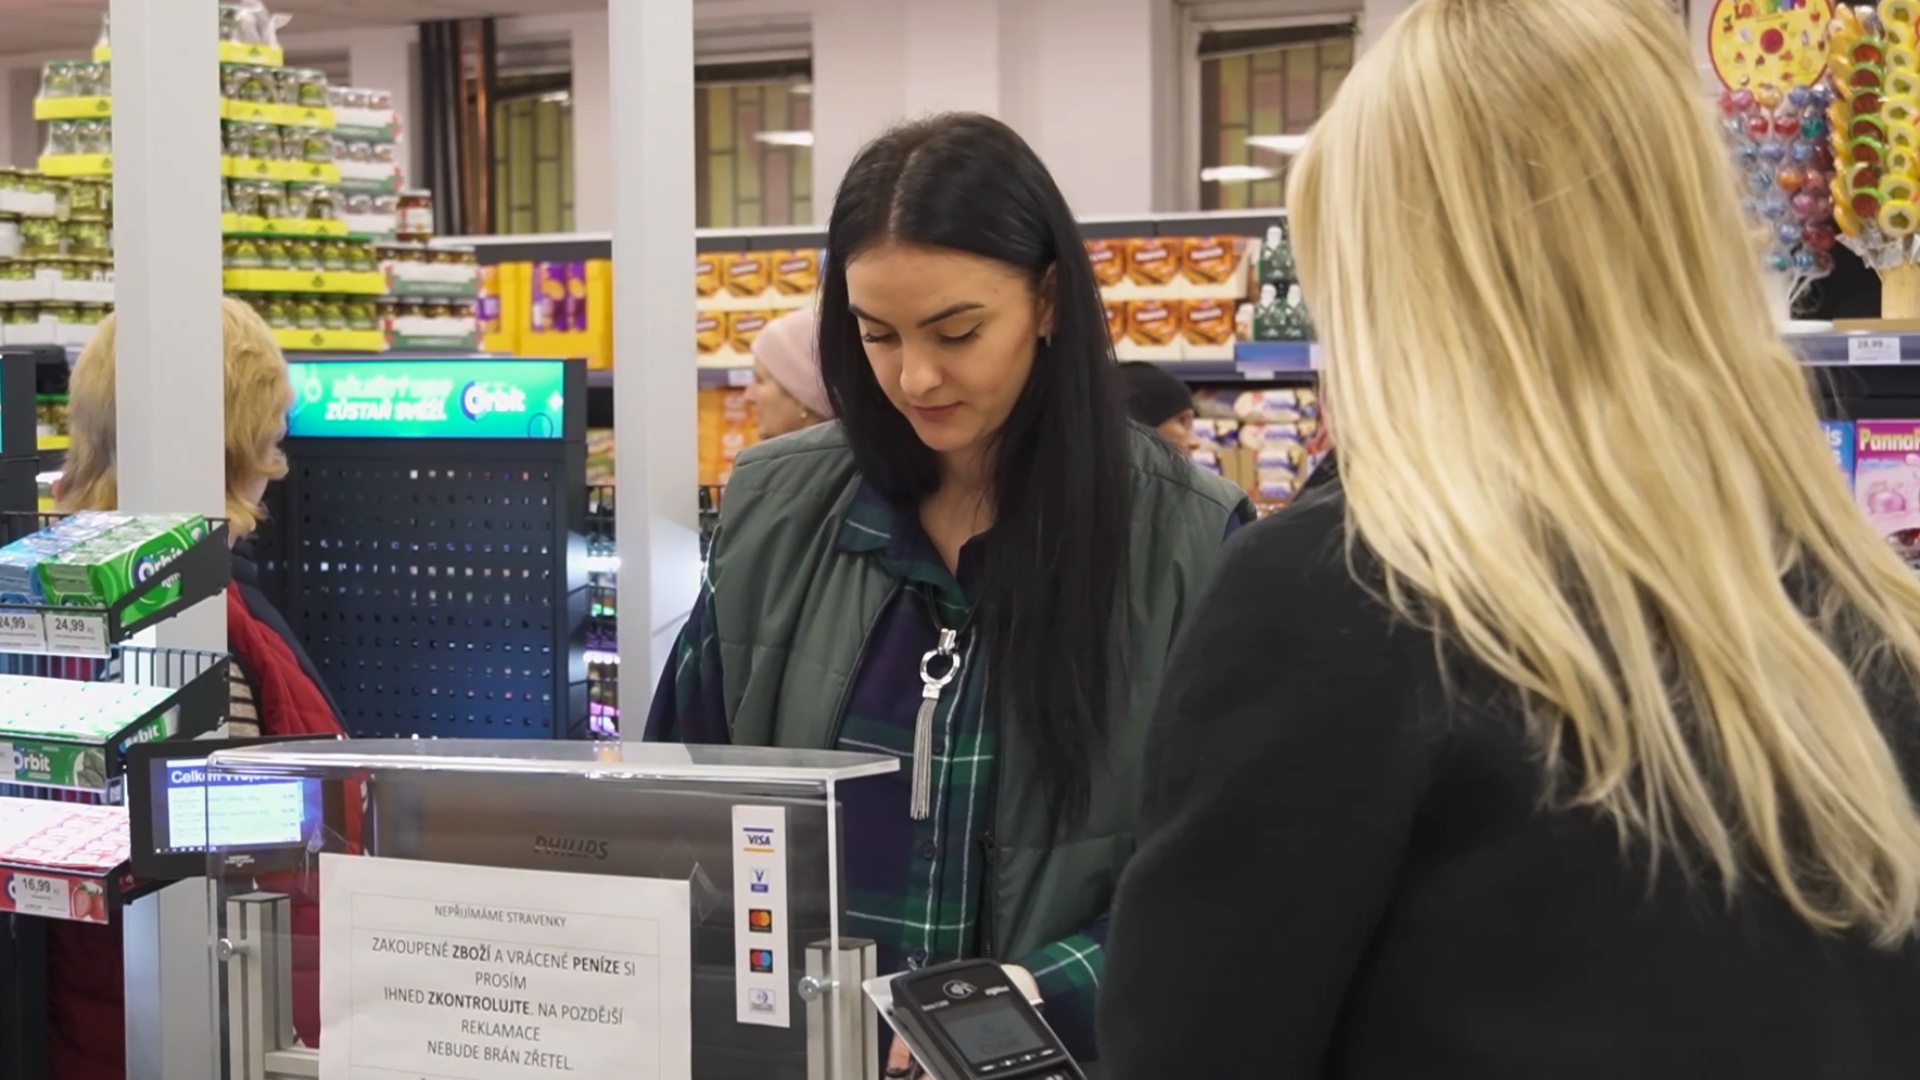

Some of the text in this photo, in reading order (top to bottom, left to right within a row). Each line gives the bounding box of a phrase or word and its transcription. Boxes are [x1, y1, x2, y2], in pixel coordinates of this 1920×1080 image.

[464, 385, 526, 414] Orbit
[55, 618, 85, 633] 24,99
[12, 750, 51, 772] Orbit
[534, 835, 608, 860] PHILIPS
[748, 835, 771, 846] VISA
[22, 877, 52, 894] 16,99
[434, 905, 567, 928] NEPŘIJÍMÁME STRAVENKY
[372, 937, 636, 977] ZAKOUPENÉ ZBOŽÍ A VRÁCENÉ PENÍZE SI
[475, 971, 527, 990] PROSÍM
[384, 987, 624, 1026] IHNED ZKONTROLUJTE. NA POZDĚJŠÍ
[461, 1019, 541, 1042] REKLAMACE
[427, 1040, 574, 1072] NEBUDE BRÁN ZŘETEL.
